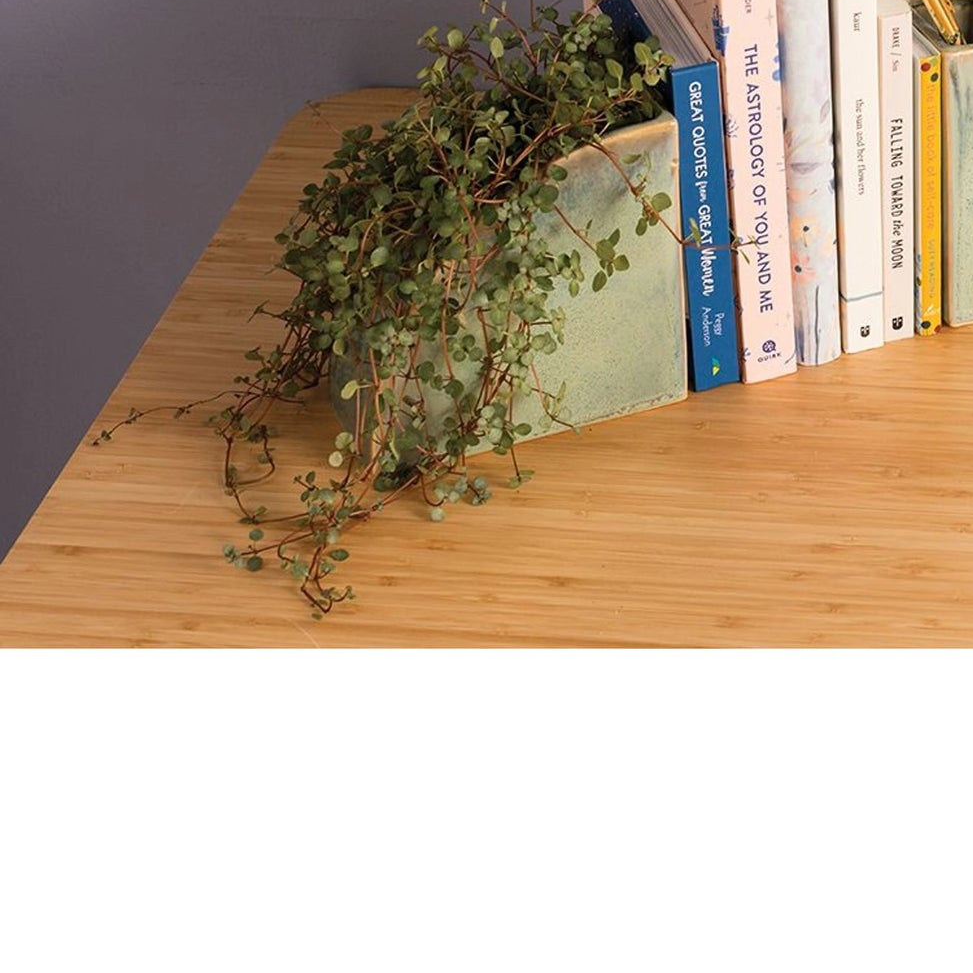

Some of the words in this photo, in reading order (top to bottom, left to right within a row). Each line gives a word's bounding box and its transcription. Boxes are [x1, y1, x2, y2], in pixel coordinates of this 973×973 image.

[853, 11, 862, 32] kaur
[744, 43, 759, 77] THE
[688, 81, 704, 122] GREAT
[856, 98, 865, 114] the
[746, 83, 766, 178] ASTROLOGY
[856, 114, 864, 130] sun
[692, 125, 708, 179] QUOTES
[856, 131, 866, 148] and
[856, 148, 867, 163] her
[890, 117, 904, 169] FALLING
[752, 184, 767, 206] OF
[857, 163, 867, 196] flowers
[890, 174, 904, 218] TOWARD
[698, 204, 714, 244] GREAT
[754, 211, 769, 246] YOU
[891, 219, 904, 237] the
[757, 251, 772, 285] AND
[890, 238, 904, 269] MOON
[700, 246, 715, 297] Women
[759, 290, 774, 314] ME
[701, 306, 714, 347] Anderson
[713, 312, 725, 336] Peggy
[757, 352, 782, 364] QUIRK
